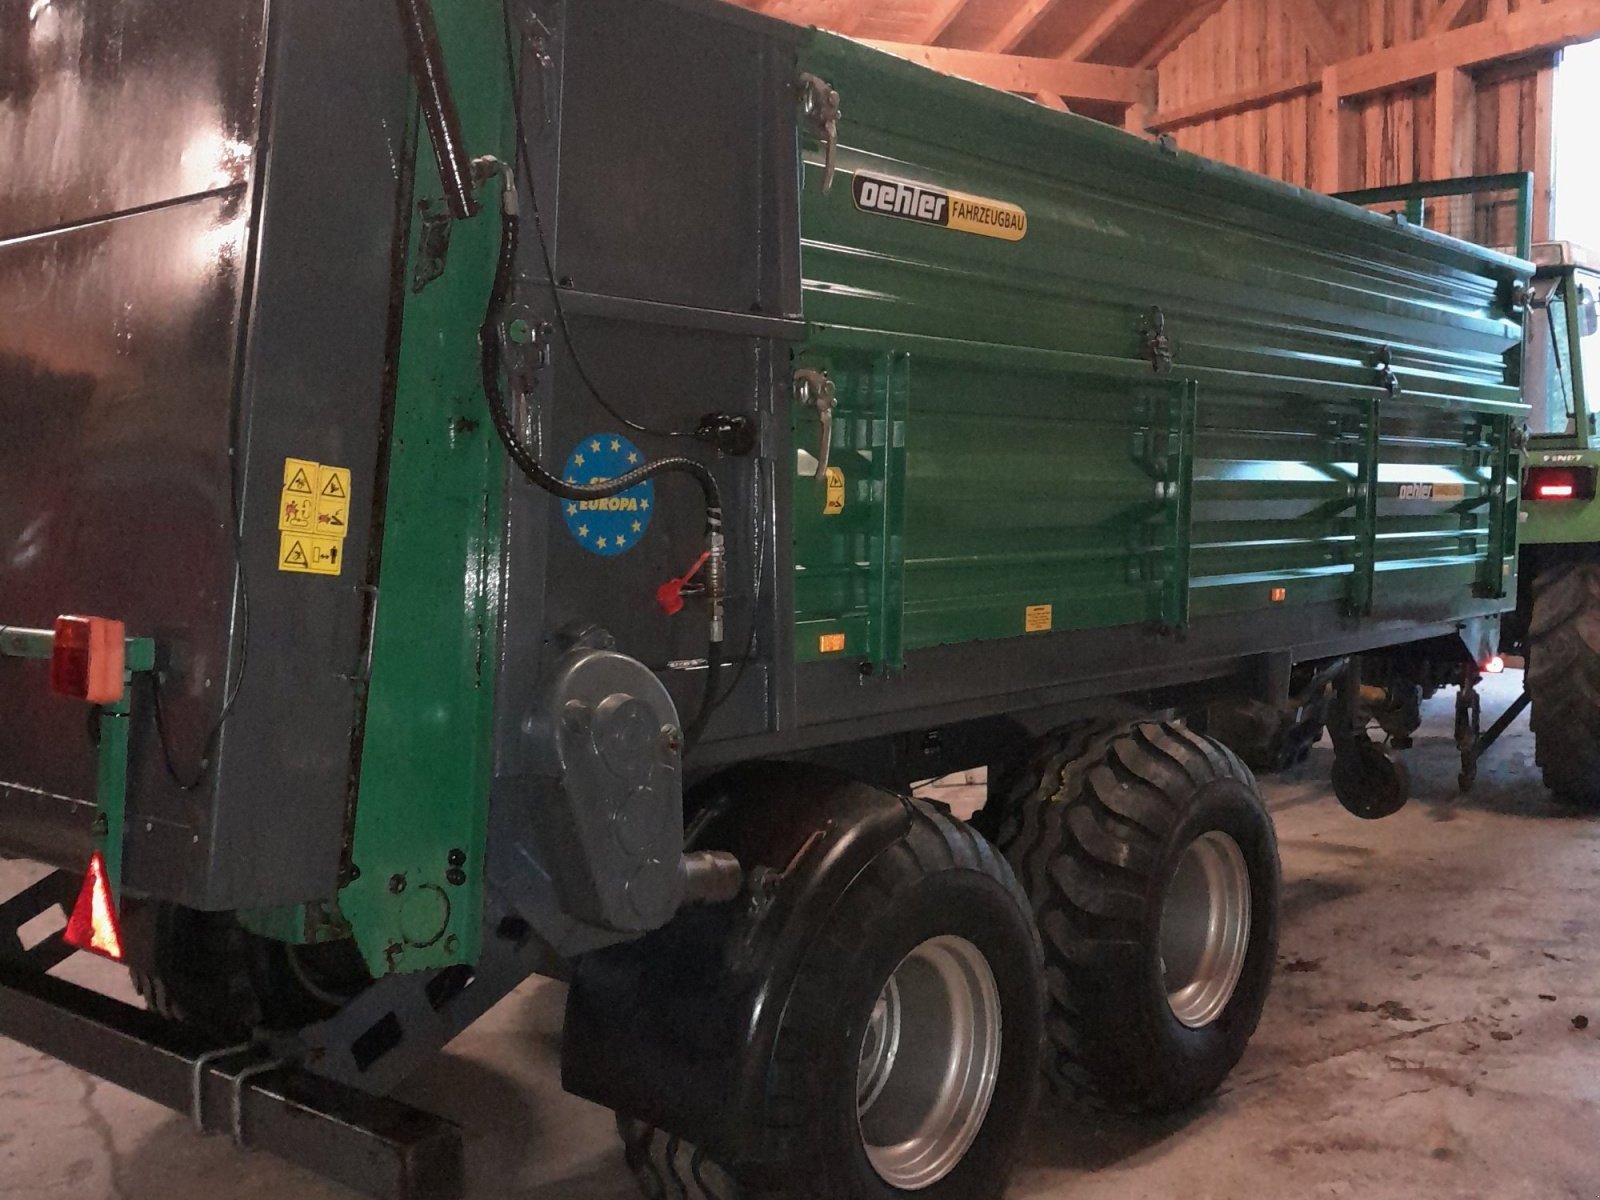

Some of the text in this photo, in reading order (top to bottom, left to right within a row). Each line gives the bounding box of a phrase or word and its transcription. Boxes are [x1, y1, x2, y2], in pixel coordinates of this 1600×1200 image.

[859, 181, 1025, 231] oehler FAHRZEUGBAU
[579, 497, 638, 511] EUROPA
